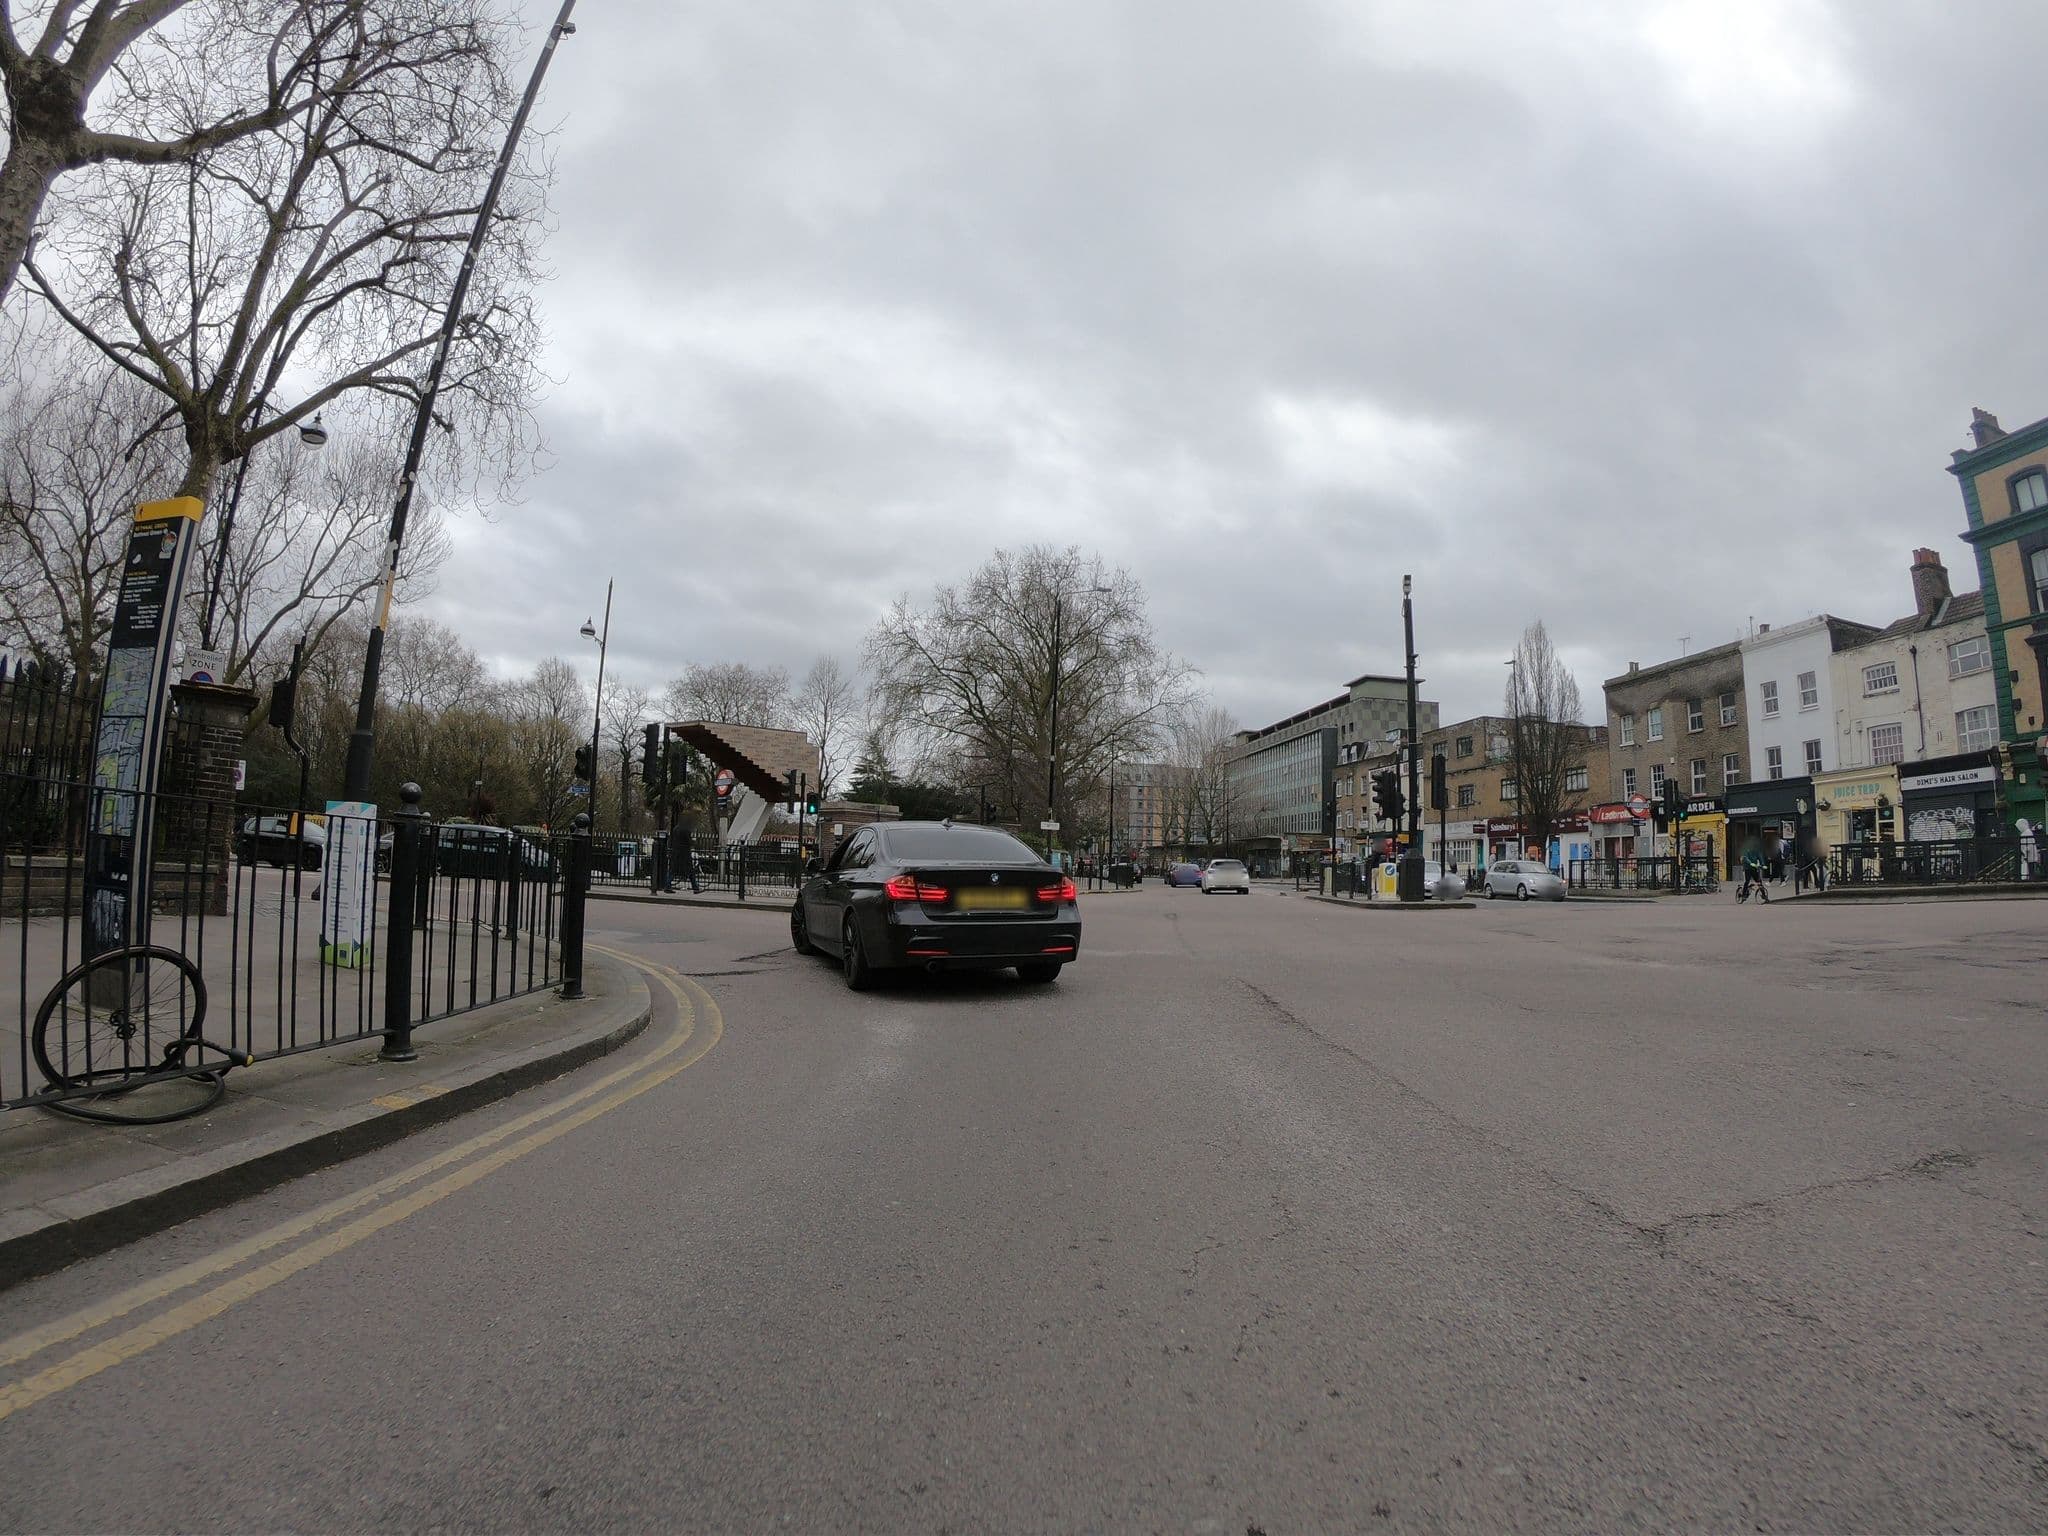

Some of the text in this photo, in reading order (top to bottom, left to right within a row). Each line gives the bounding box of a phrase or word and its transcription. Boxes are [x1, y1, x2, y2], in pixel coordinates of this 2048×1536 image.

[187, 649, 223, 663] Controlled
[191, 659, 217, 671] ZONE
[1939, 775, 1956, 783] HAIR
[1957, 772, 1979, 781] SALON
[1833, 786, 1856, 799] JUICE
